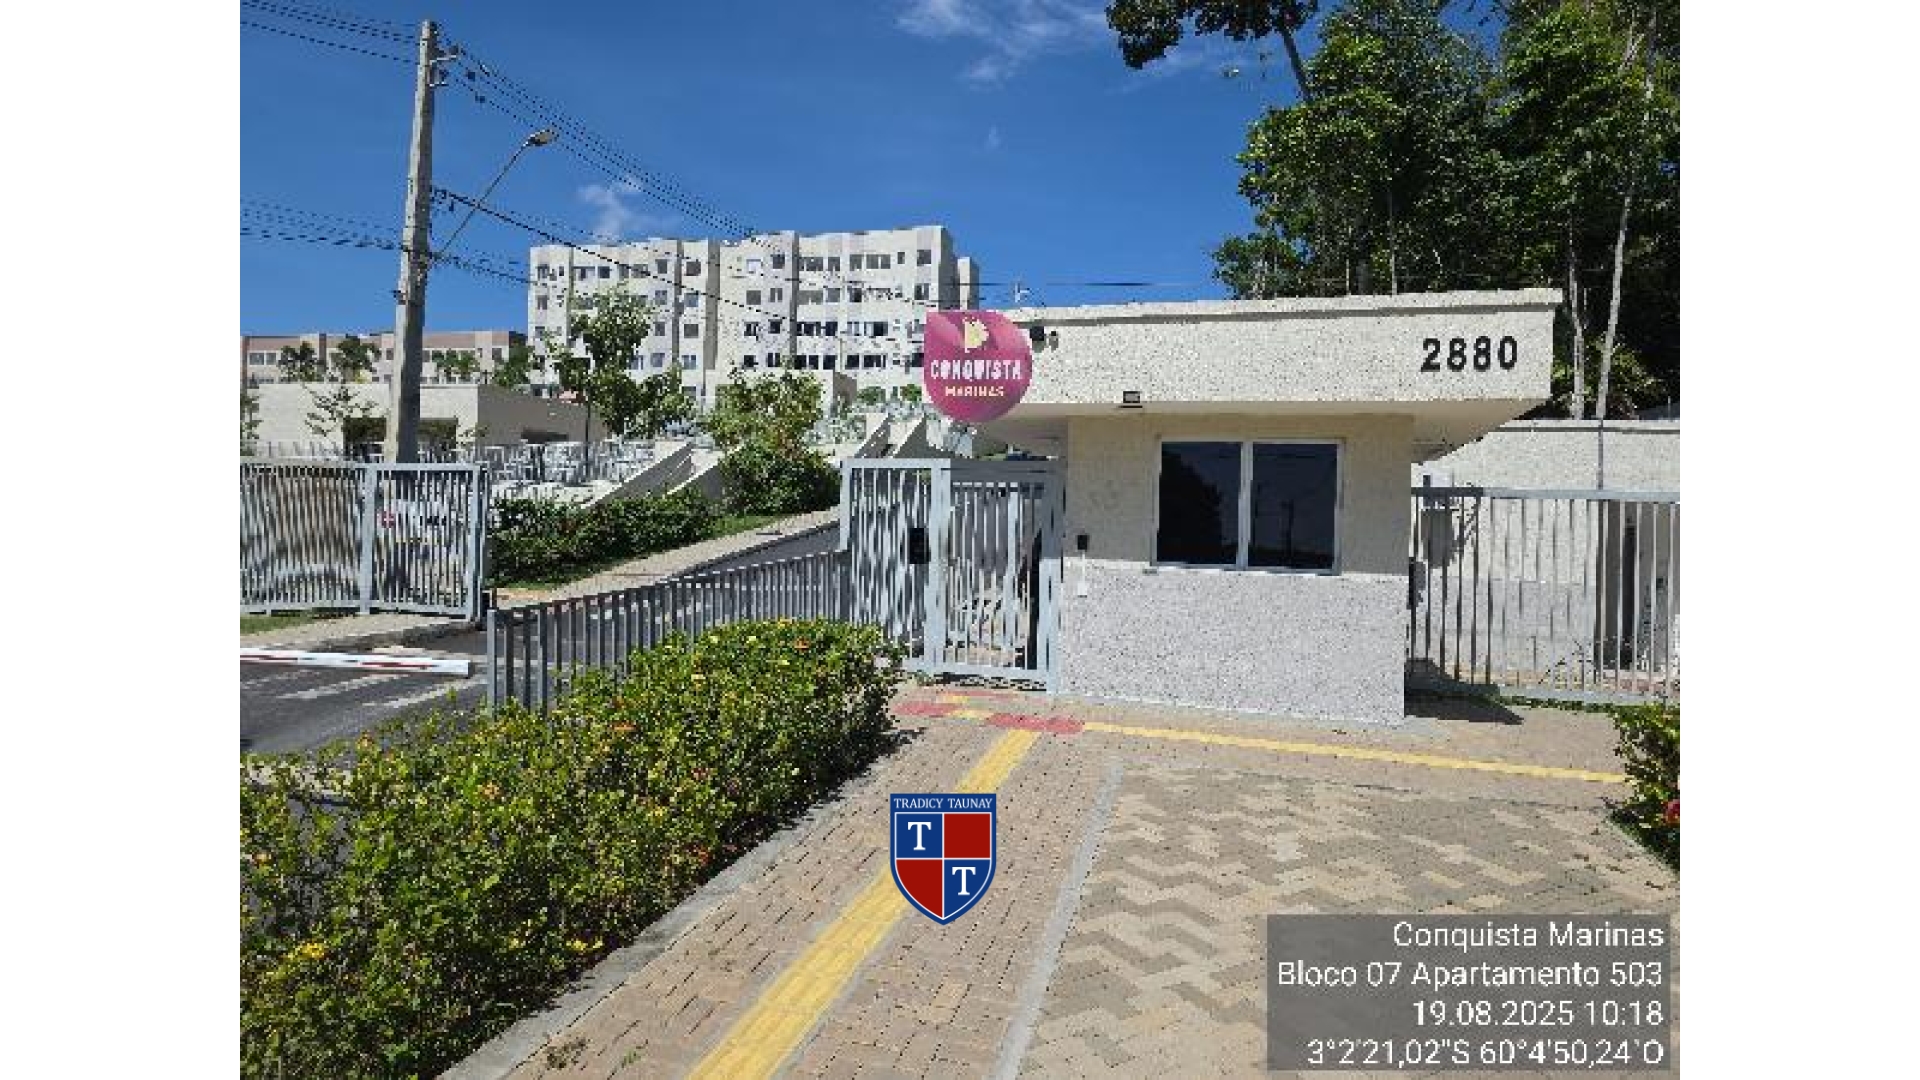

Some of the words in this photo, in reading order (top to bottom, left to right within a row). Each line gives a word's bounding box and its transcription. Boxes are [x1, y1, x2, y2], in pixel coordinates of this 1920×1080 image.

[1420, 335, 1518, 372] 2880
[930, 359, 1022, 382] CONQUISTA
[945, 385, 1004, 397] MARINAS
